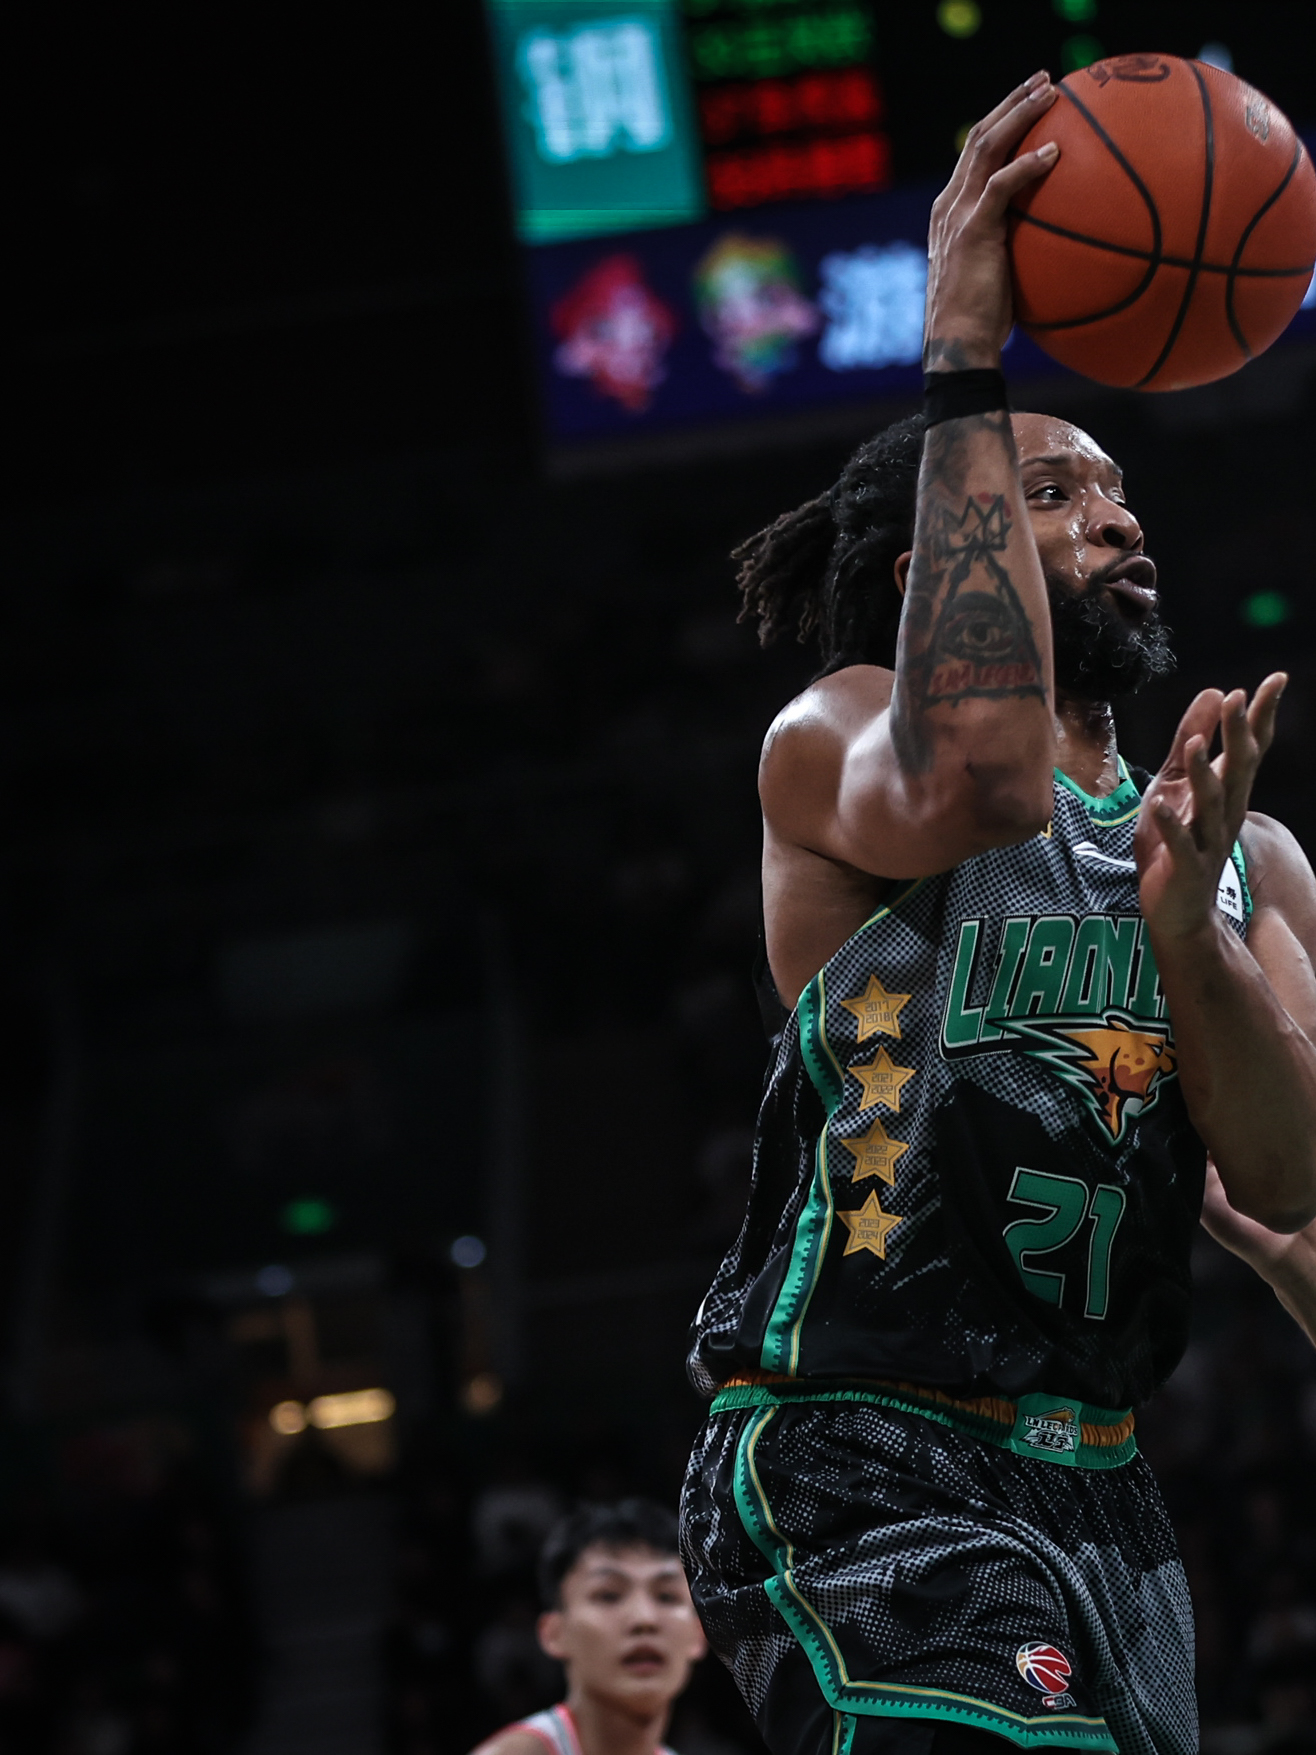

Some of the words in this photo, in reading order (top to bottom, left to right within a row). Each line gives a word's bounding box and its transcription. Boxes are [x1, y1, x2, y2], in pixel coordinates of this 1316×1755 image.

[1220, 897, 1238, 911] LIFE
[939, 912, 1171, 1061] LIAONI
[865, 1000, 889, 1012] 2017
[866, 1012, 890, 1023] 2018
[872, 1072, 893, 1083] 2021
[871, 1084, 893, 1095] 2022
[866, 1145, 888, 1155] 2022
[865, 1156, 887, 1166] 2023
[858, 1230, 879, 1240] 2024
[1002, 1166, 1127, 1320] 21
[1042, 1692, 1078, 1710] CBA
